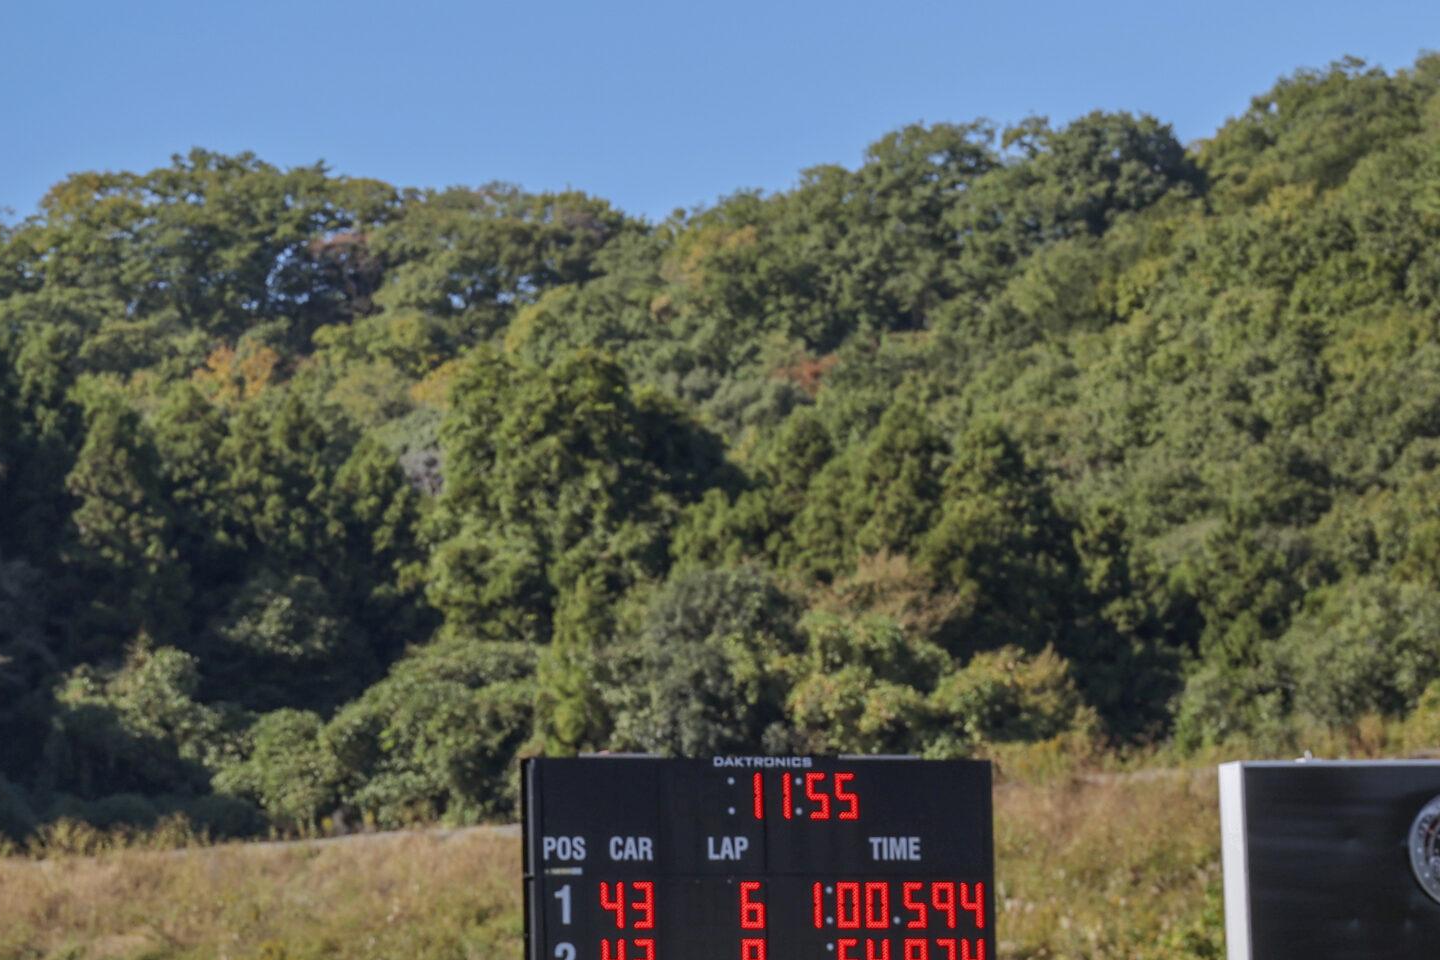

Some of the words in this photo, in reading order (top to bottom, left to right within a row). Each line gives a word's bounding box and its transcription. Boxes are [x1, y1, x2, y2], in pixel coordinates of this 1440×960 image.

[713, 756, 813, 768] DAKTRONICS
[543, 836, 586, 861] POS
[609, 836, 653, 861] CAR
[707, 836, 749, 861] LAP
[869, 836, 921, 861] TIME
[554, 884, 571, 925] 1
[600, 881, 655, 929] 43
[740, 881, 766, 930] 6
[813, 881, 985, 929] 1:00.594
